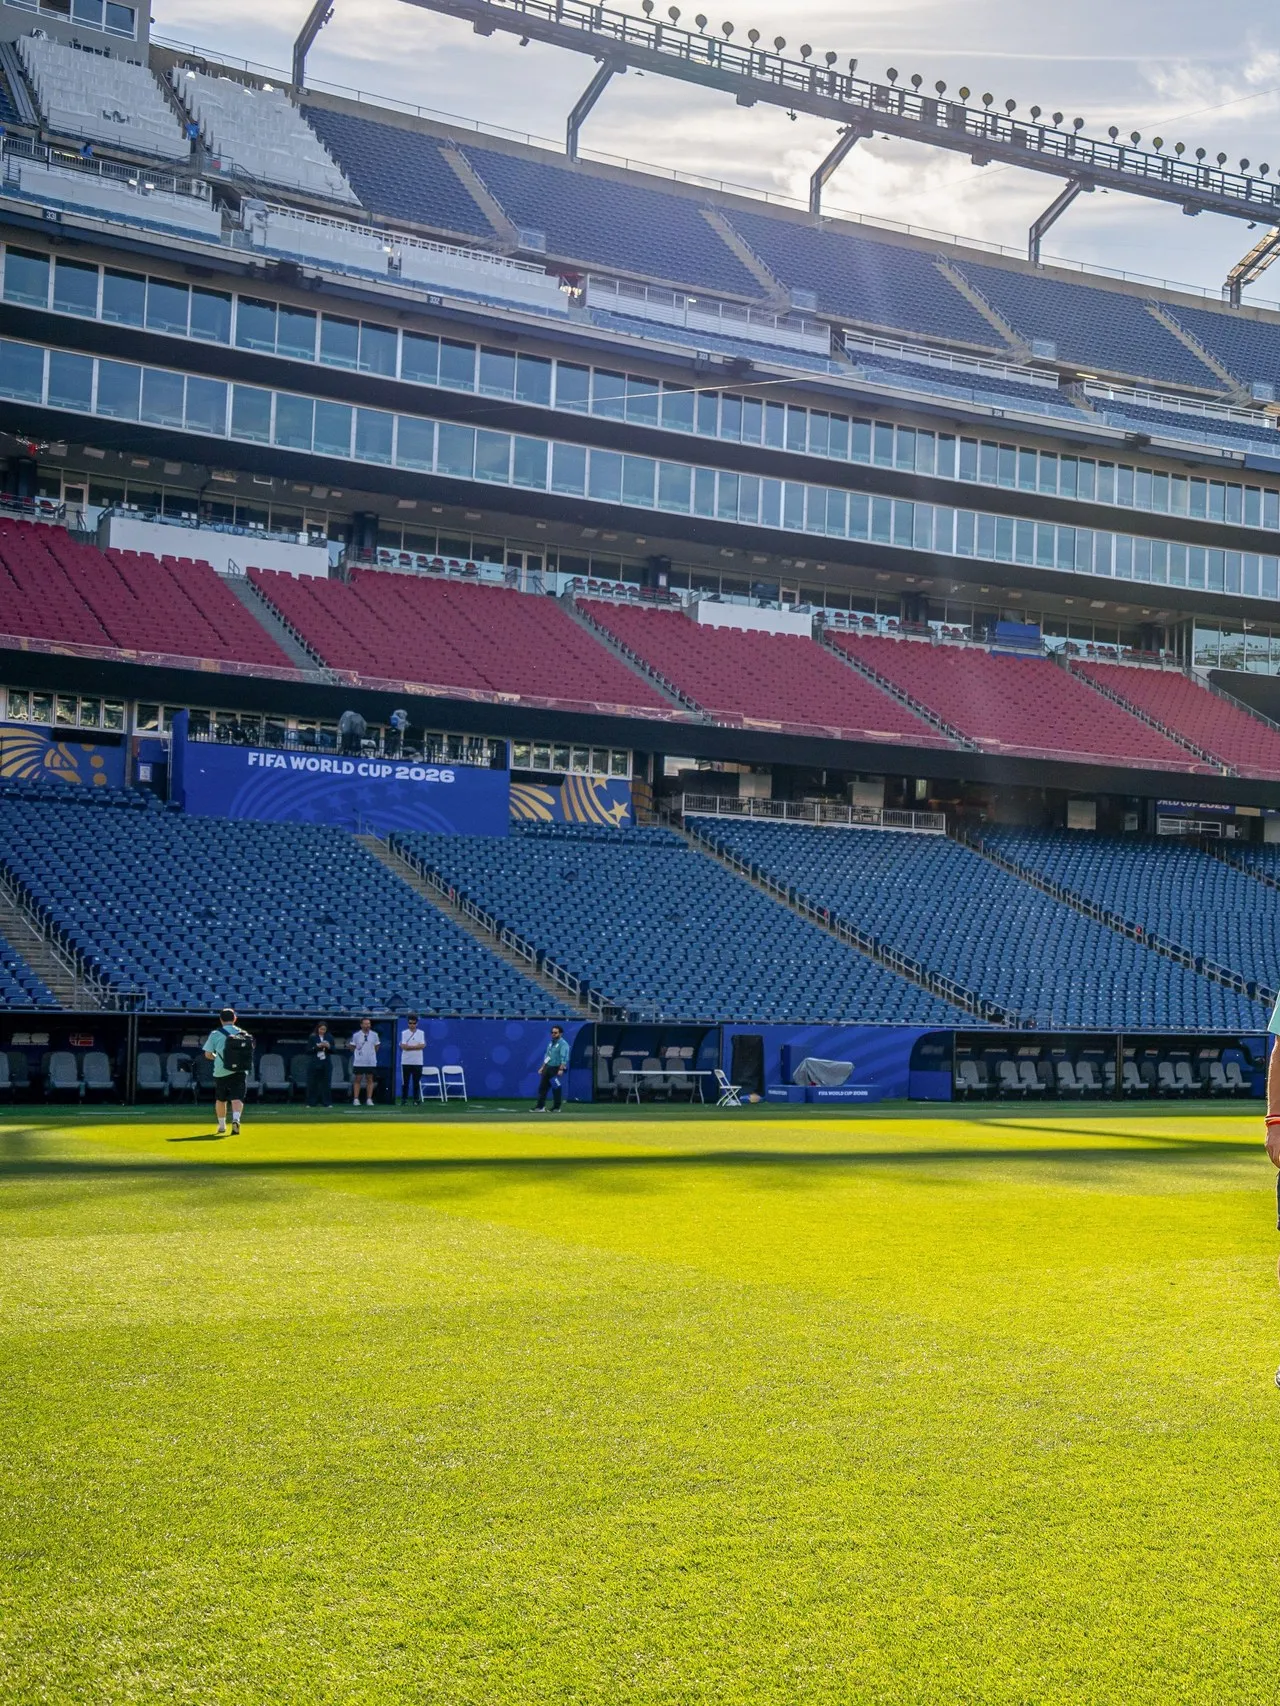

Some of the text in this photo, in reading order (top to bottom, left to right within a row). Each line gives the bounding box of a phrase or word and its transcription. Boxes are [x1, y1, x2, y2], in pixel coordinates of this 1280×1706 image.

[248, 751, 455, 783] FIFA WORLD CUP 2026
